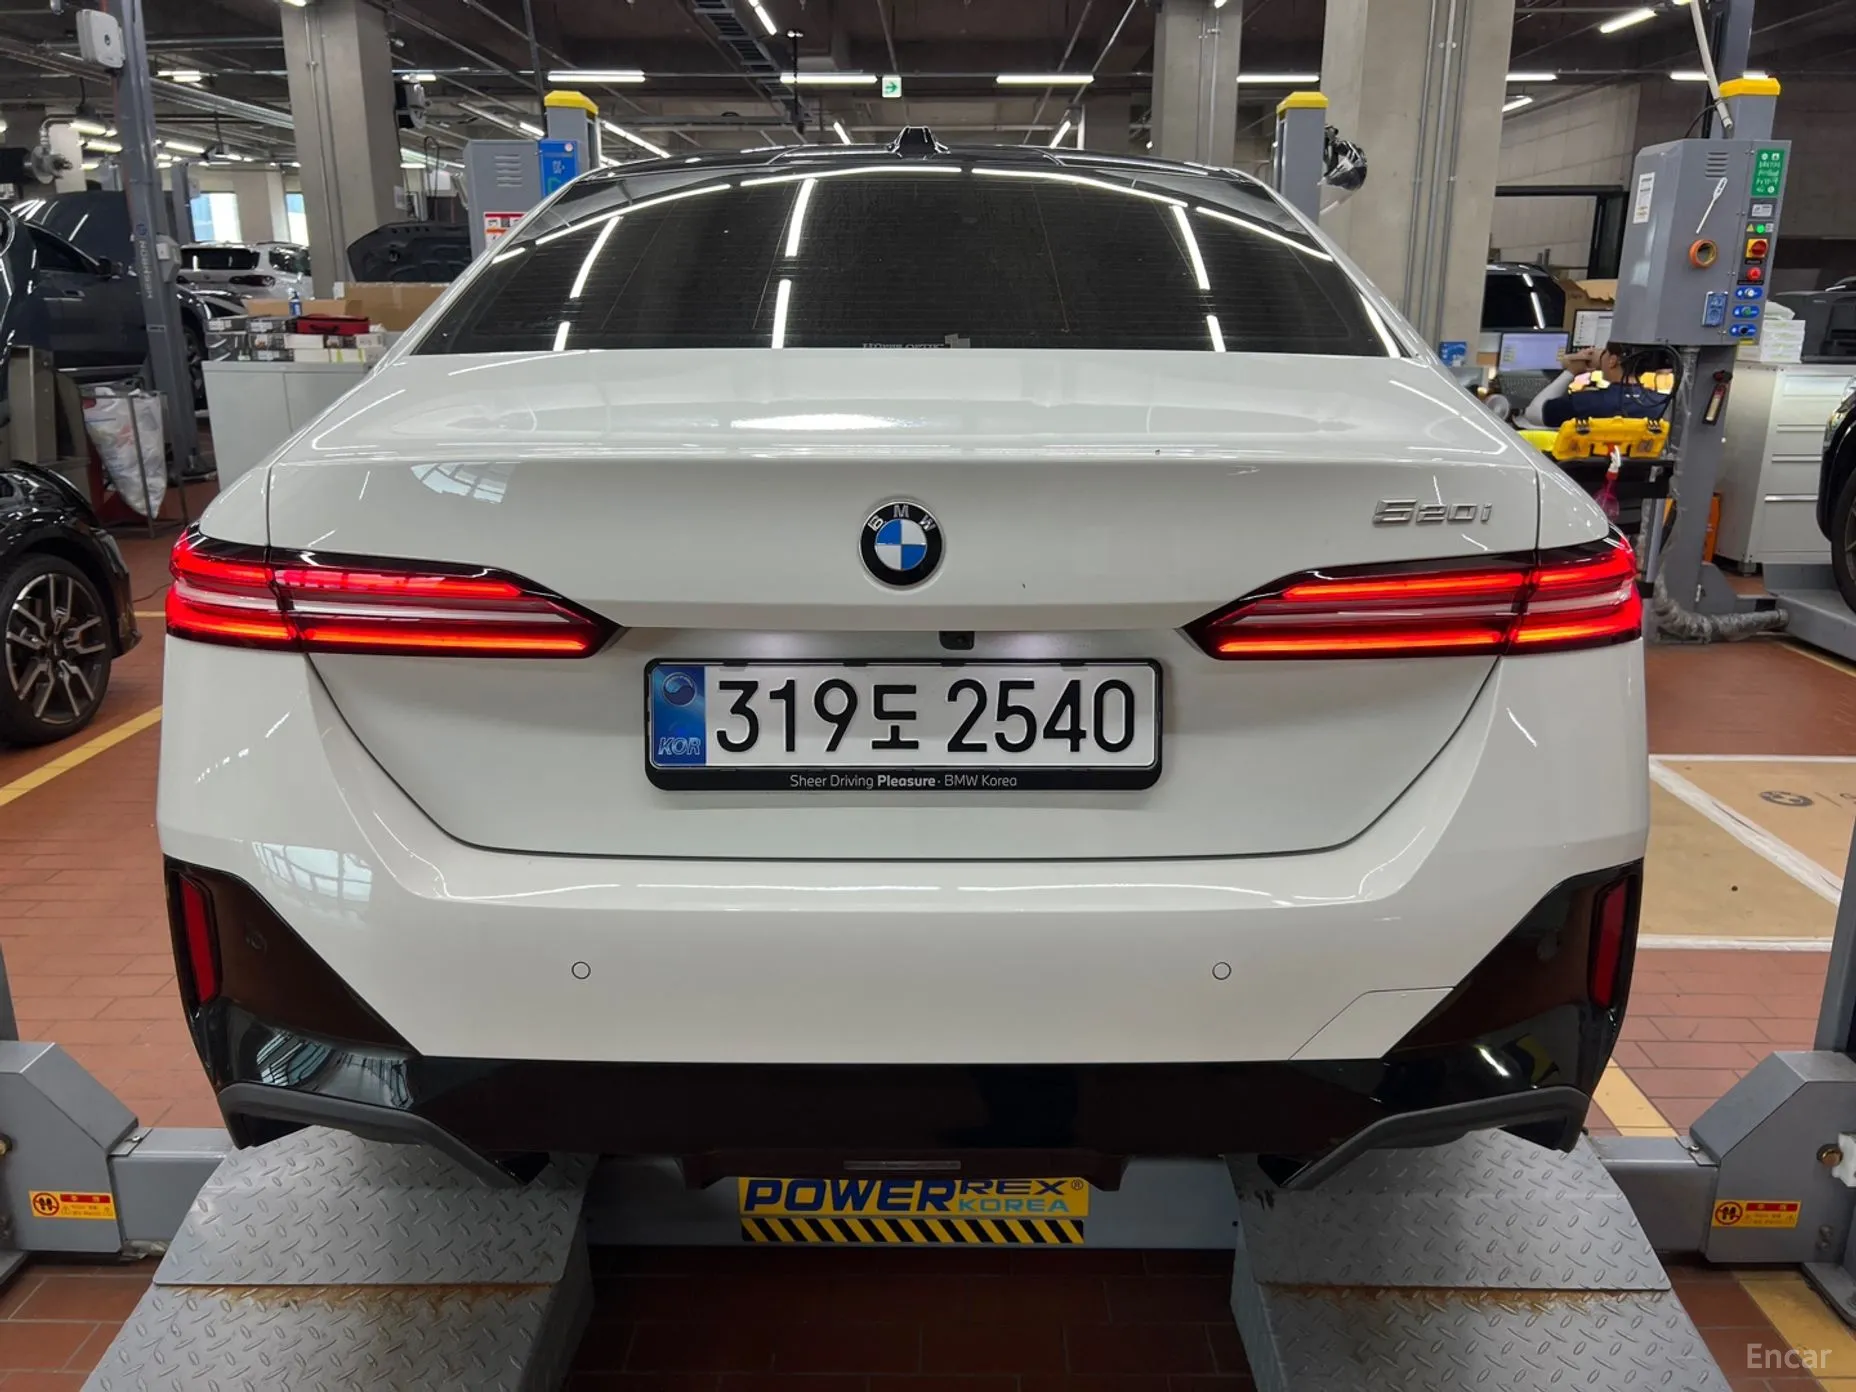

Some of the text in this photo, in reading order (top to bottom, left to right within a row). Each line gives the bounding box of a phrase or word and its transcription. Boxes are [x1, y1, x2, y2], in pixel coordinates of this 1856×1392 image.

[867, 504, 936, 531] BMW
[1373, 498, 1492, 524] 520i
[716, 679, 1135, 752] 319도 2540
[658, 737, 701, 755] KOR
[790, 775, 827, 787] Sheer
[830, 775, 873, 789] Driving
[944, 775, 979, 787] BMW
[981, 775, 1017, 787] Korea
[958, 1199, 1070, 1213] KOREA
